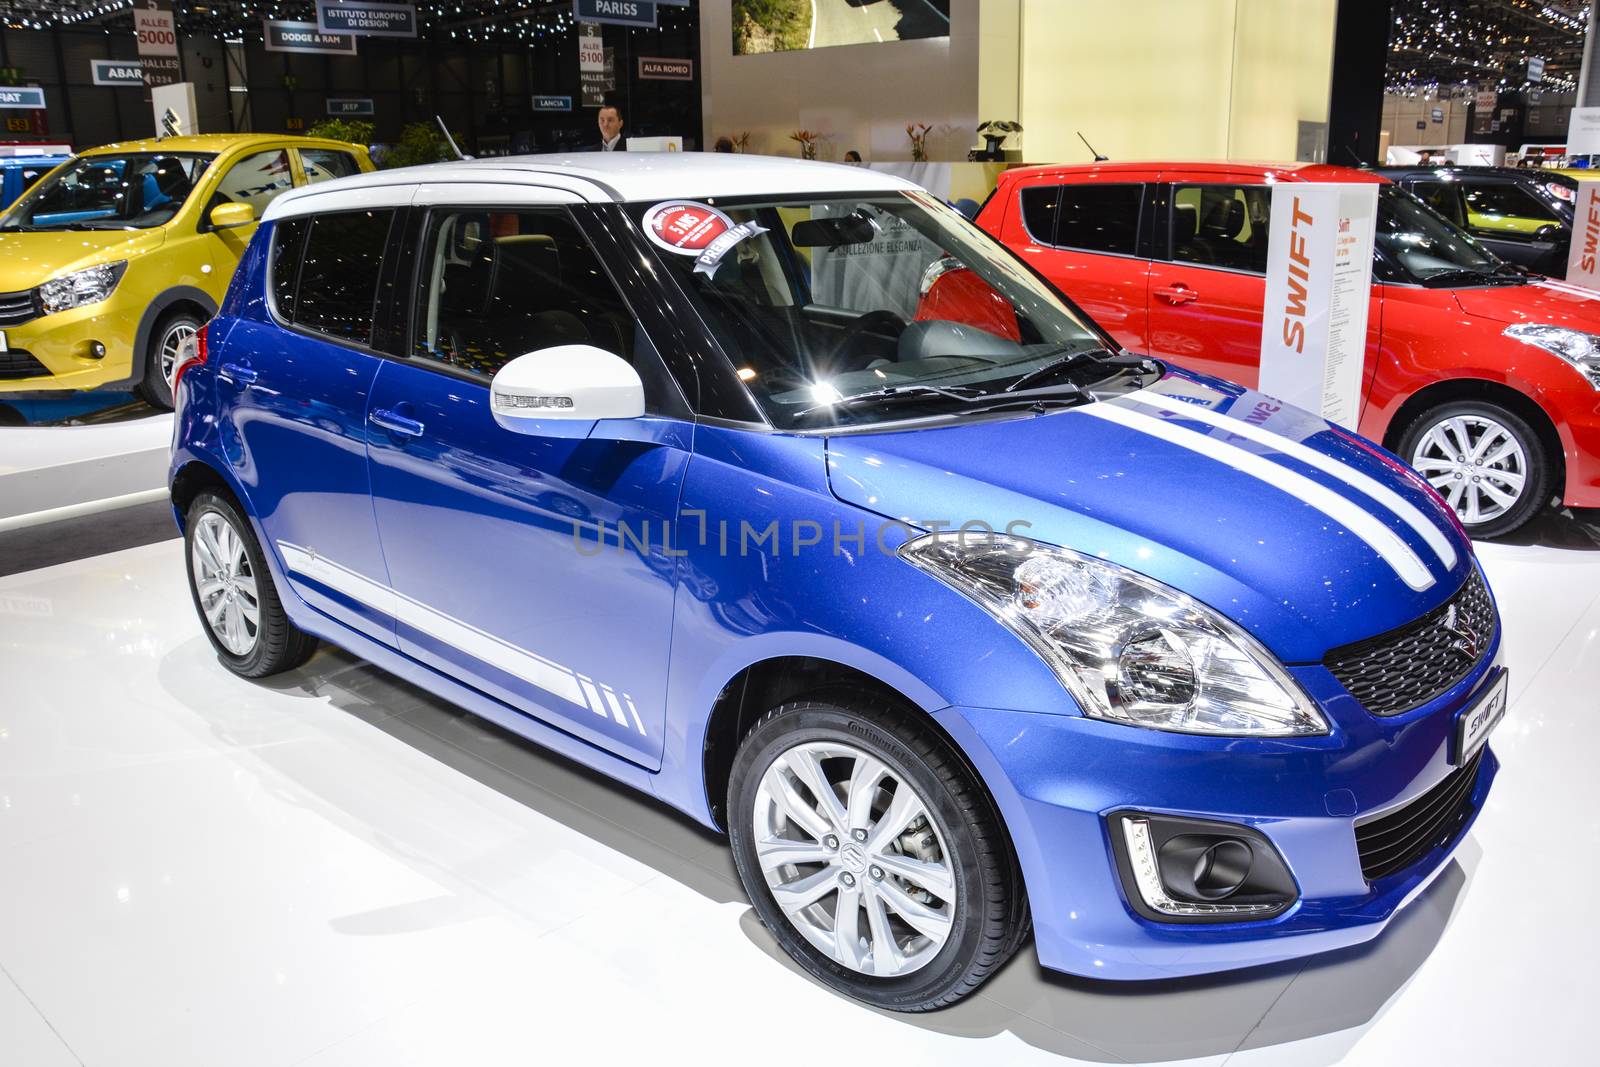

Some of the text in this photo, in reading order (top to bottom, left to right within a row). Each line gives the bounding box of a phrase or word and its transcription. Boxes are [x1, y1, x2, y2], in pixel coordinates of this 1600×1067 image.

[595, 0, 638, 16] PARISS
[327, 9, 407, 21] ISTITUTO EUROPEO
[348, 19, 389, 28] DI DESIGN
[139, 30, 175, 45] 5000
[281, 32, 313, 42] DODGE
[322, 34, 341, 43] RAM
[580, 52, 603, 63] 5100
[644, 64, 688, 74] ALFA ROMEO
[540, 100, 564, 108] LANCIA
[673, 213, 700, 231] ANS
[668, 225, 685, 235] 5
[699, 224, 741, 265] PREMIUM
[886, 240, 922, 253] ELEGANZA
[1283, 196, 1313, 354] SWIFT
[1469, 689, 1502, 738] SWIFT
[847, 720, 906, 759] Continental
